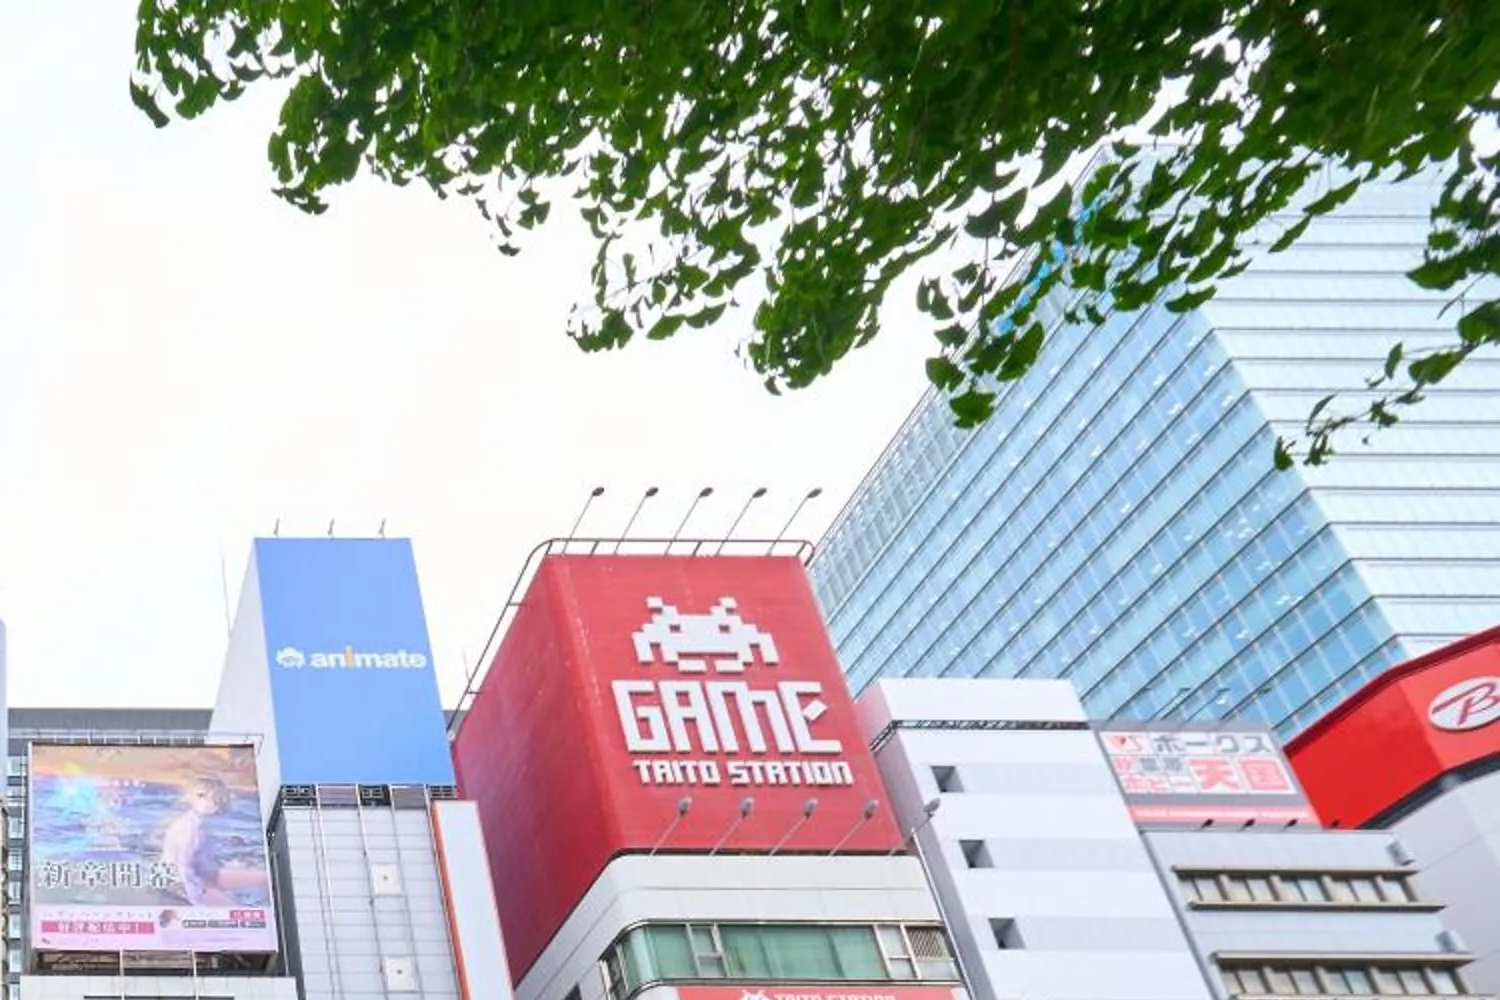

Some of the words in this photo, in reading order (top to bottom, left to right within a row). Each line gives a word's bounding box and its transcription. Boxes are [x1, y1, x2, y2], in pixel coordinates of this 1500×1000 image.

[311, 645, 427, 669] animate
[610, 680, 844, 752] GAME
[632, 760, 721, 784] TAITO
[727, 761, 854, 785] STATION
